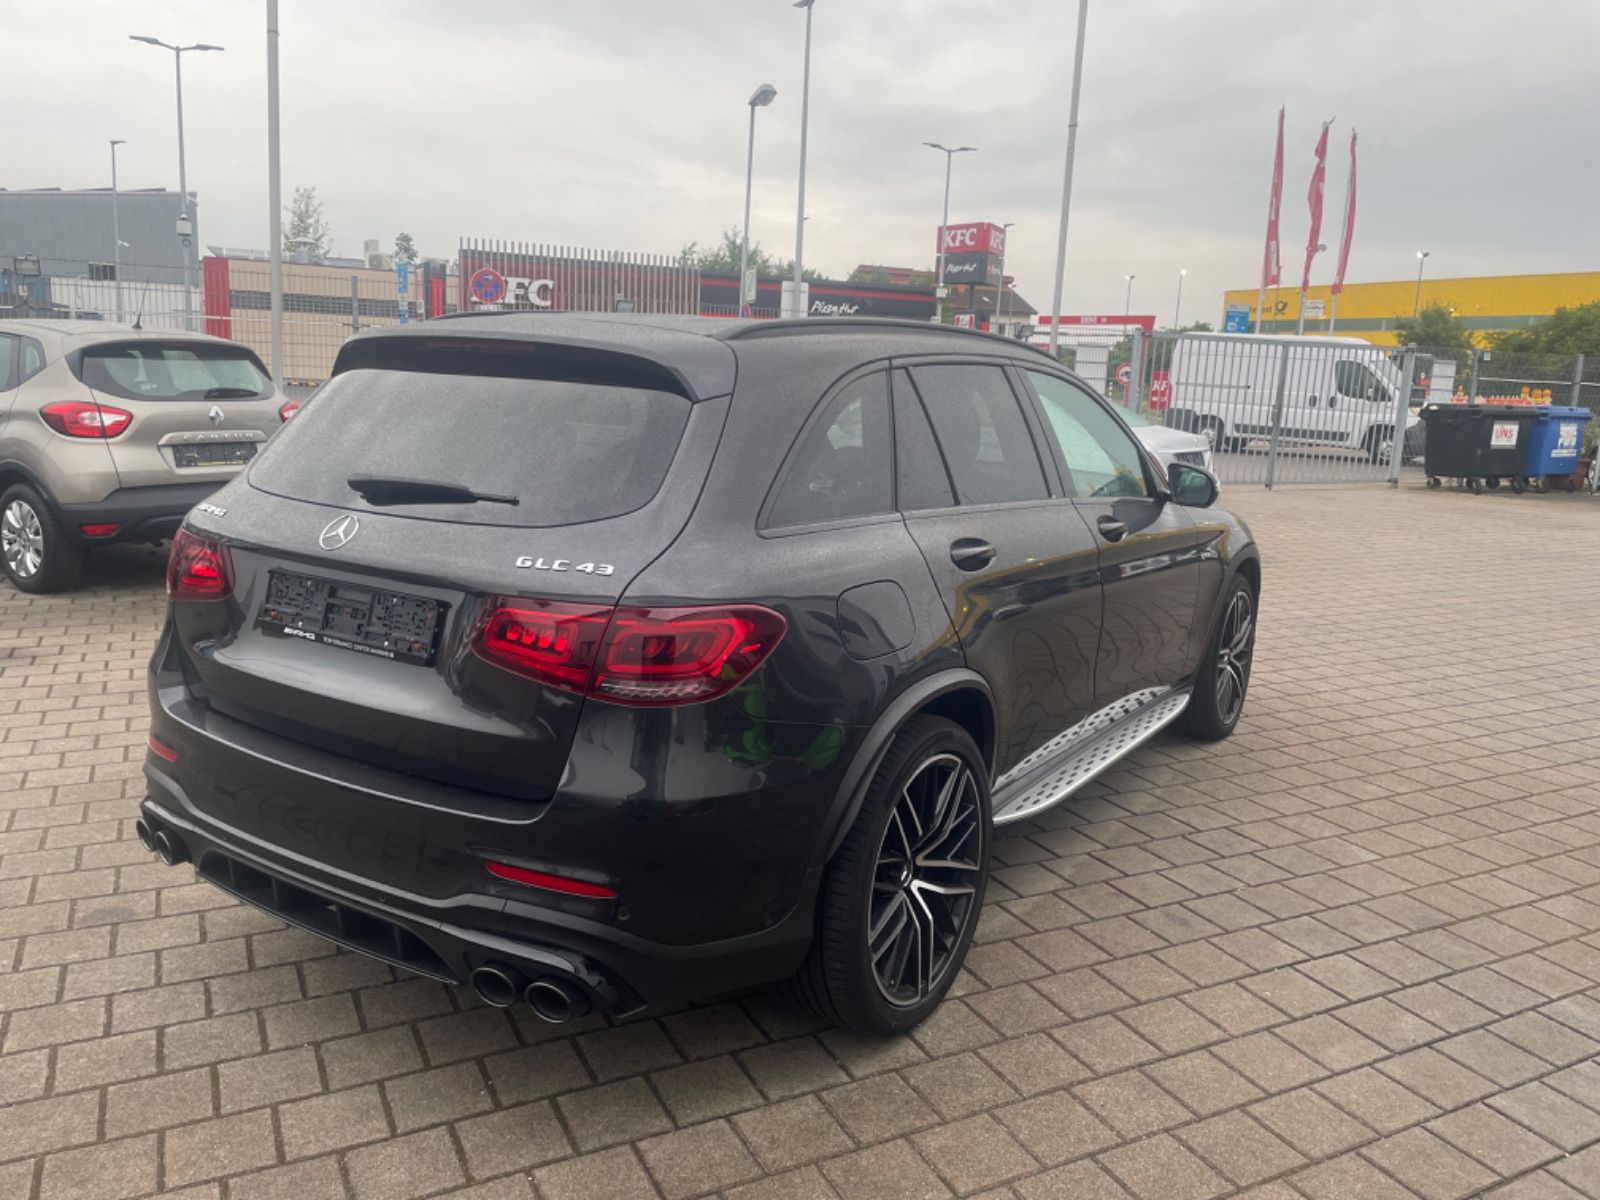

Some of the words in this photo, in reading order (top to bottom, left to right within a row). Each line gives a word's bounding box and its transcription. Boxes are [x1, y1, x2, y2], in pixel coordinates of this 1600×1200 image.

[943, 228, 977, 247] KFC
[469, 276, 555, 307] FC
[811, 300, 839, 313] Pizza
[839, 302, 860, 314] Hut
[515, 556, 571, 572] GLC
[575, 562, 616, 577] 43
